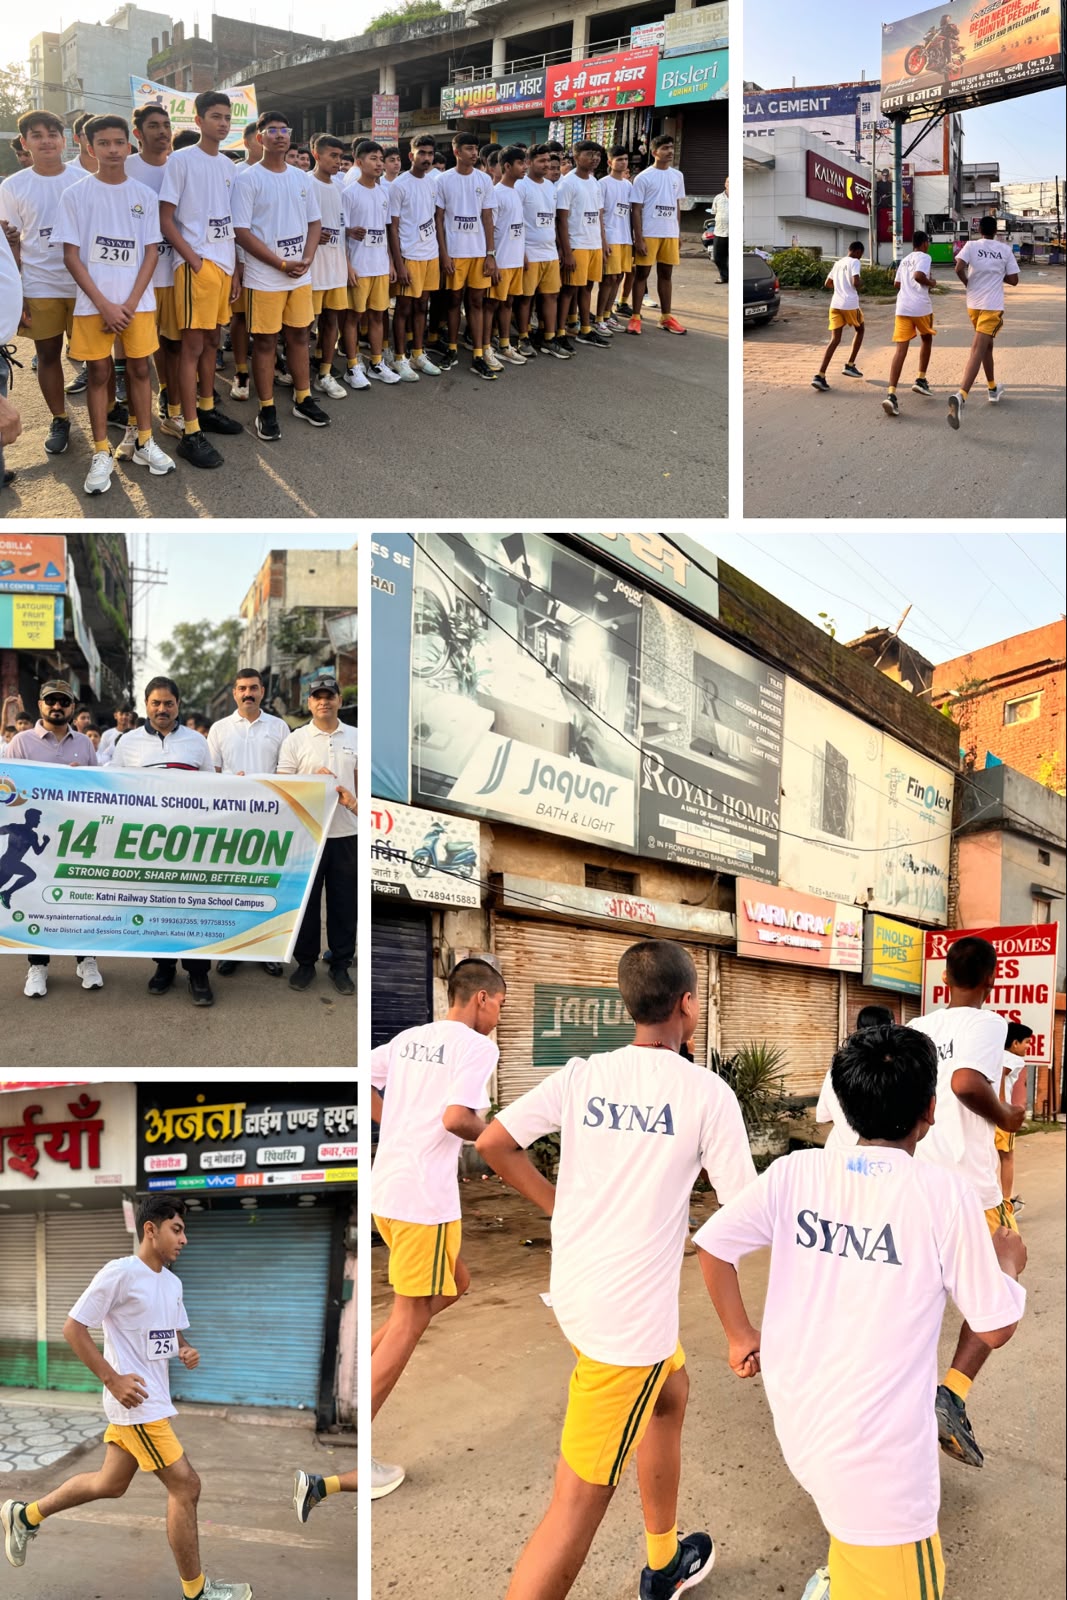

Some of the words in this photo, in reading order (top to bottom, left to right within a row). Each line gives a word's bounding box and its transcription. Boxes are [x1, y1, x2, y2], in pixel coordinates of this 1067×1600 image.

[969, 14, 990, 34] GEAR
[977, 17, 1006, 39] DUNIYA
[983, 33, 996, 44] FAST
[1007, 12, 1040, 32] INTELLIGENT
[519, 74, 543, 96] भंडार
[553, 75, 570, 98] दुबे
[573, 71, 587, 89] जी
[589, 72, 612, 87] पान
[614, 65, 647, 83] भंडार
[661, 61, 718, 90] Bisleri
[170, 99, 186, 114] 14
[768, 96, 831, 114] CEMENT
[882, 94, 904, 110] तारा
[814, 162, 845, 189] KALYAN
[657, 209, 672, 217] 269
[99, 246, 130, 262] 230
[283, 245, 303, 257] 234
[977, 249, 1003, 260] SYNA
[392, 551, 411, 569] SE
[9, 583, 35, 591] CENTER
[16, 602, 53, 610] SATGURU
[22, 611, 46, 619] FRUIT
[769, 677, 783, 690] TILES
[735, 699, 758, 716] WOODEN
[757, 710, 781, 727] FLOORING
[761, 699, 782, 716] FAUCETS
[748, 719, 760, 730] PIPE
[750, 746, 764, 758] LIGHT
[518, 758, 619, 808] Jaquar
[641, 748, 718, 812] ROYAL
[721, 793, 780, 831] HOMES
[31, 787, 64, 801] SYNA
[67, 790, 158, 808] INTERNATIONAL
[161, 796, 210, 812] SCHOOL,
[212, 798, 247, 812] KATNI
[249, 799, 280, 815] (M.P)
[536, 802, 570, 821] BATH
[570, 812, 578, 824] &
[581, 815, 616, 834] LIGHT
[686, 805, 699, 814] UNIT
[699, 807, 707, 816] OF
[725, 816, 748, 831] GANESHA
[748, 822, 778, 841] ENTERPRISES
[56, 819, 101, 859] 14
[101, 815, 115, 825] TH
[114, 822, 294, 867] ECOTHON
[656, 840, 664, 850] IN
[664, 841, 686, 854] FRONT
[686, 848, 696, 856] OF
[696, 850, 710, 859] ICICI
[710, 853, 727, 865] BANK,
[750, 864, 765, 874] KATNI
[68, 866, 110, 877] STRONG
[111, 868, 142, 880] BODY,
[144, 870, 179, 881] SHARP
[179, 872, 209, 884] MIND,
[210, 873, 248, 884] BETTER
[248, 875, 270, 885] LIFE
[69, 891, 95, 901] Route:
[96, 891, 116, 901] Katni
[117, 893, 148, 905] Railway
[149, 894, 177, 904] Station
[178, 896, 186, 904] to
[187, 896, 207, 907] Syna
[207, 896, 233, 906] School
[234, 897, 265, 909] Campus
[423, 890, 477, 905] 7489415883
[28, 913, 122, 922] www.synainternational.edu.in
[743, 899, 826, 936] VARMORA
[876, 927, 914, 949] FINOLEX
[881, 943, 908, 963] PIPES
[399, 1041, 445, 1065] SYNA
[144, 1093, 247, 1145] अजंता
[245, 1106, 284, 1136] टाईम
[286, 1108, 320, 1131] एण्ड
[583, 1096, 675, 1136] SYNA
[148, 1179, 177, 1188] SAMSUNG
[796, 1209, 903, 1266] SYNA
